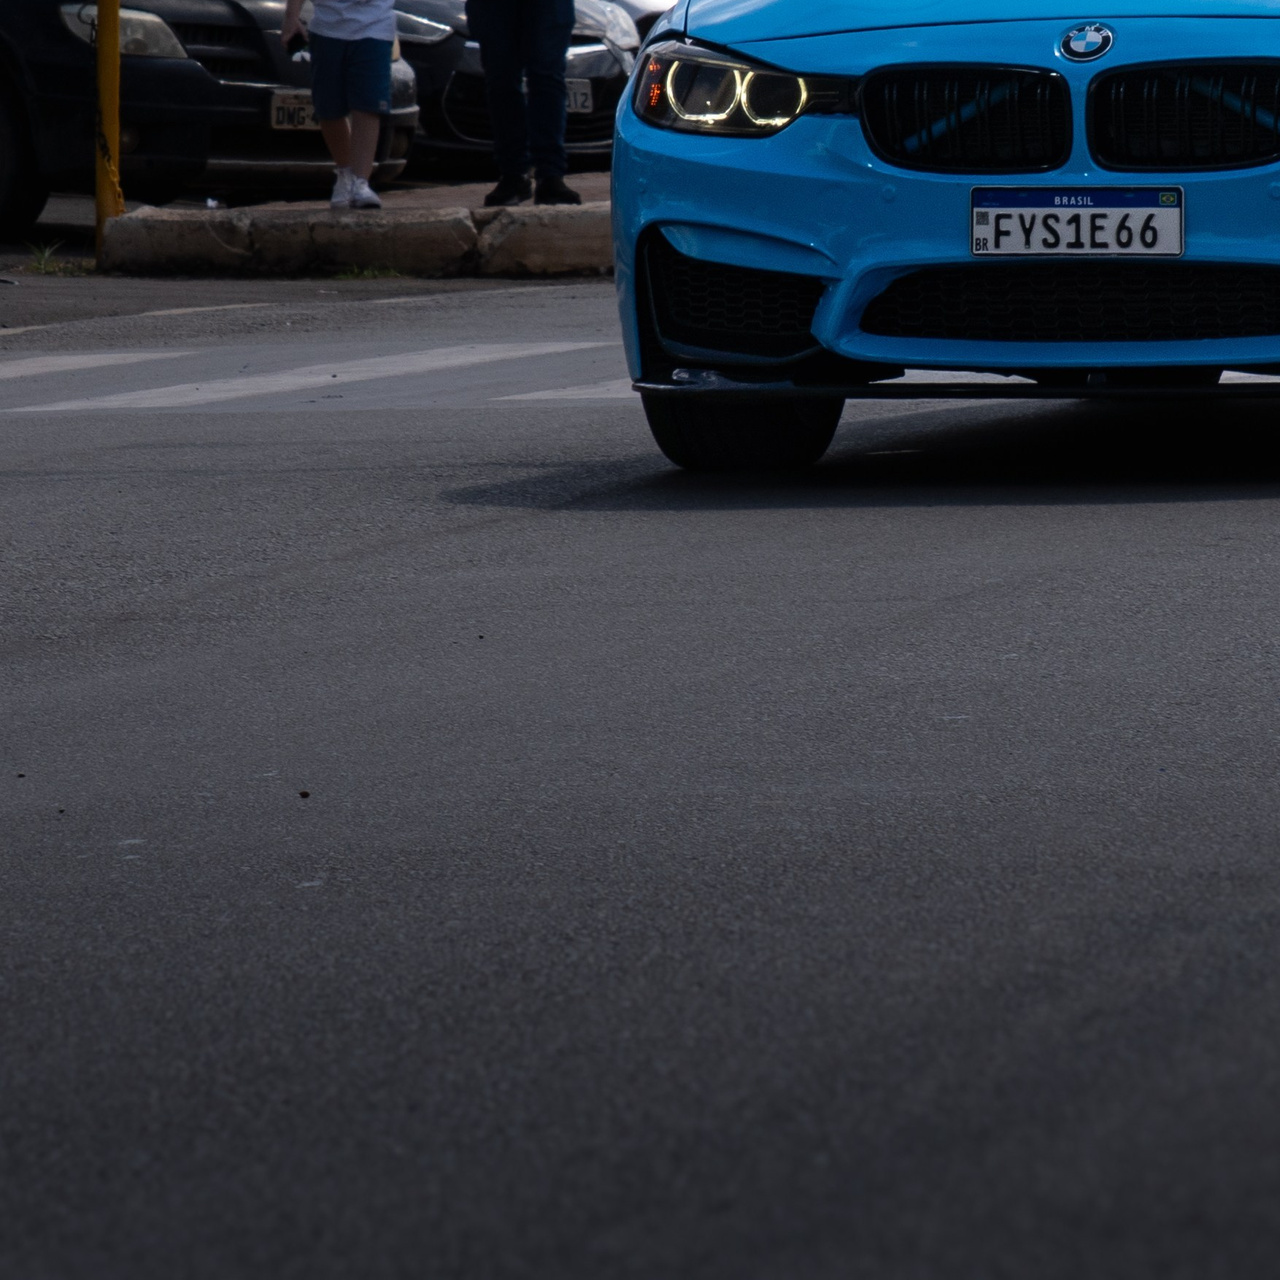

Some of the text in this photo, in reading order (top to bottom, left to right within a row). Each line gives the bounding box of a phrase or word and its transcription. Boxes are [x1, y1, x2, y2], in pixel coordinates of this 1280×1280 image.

[1054, 196, 1094, 206] BRASIL
[994, 213, 1158, 249] FYS1E66
[975, 237, 989, 252] BR
